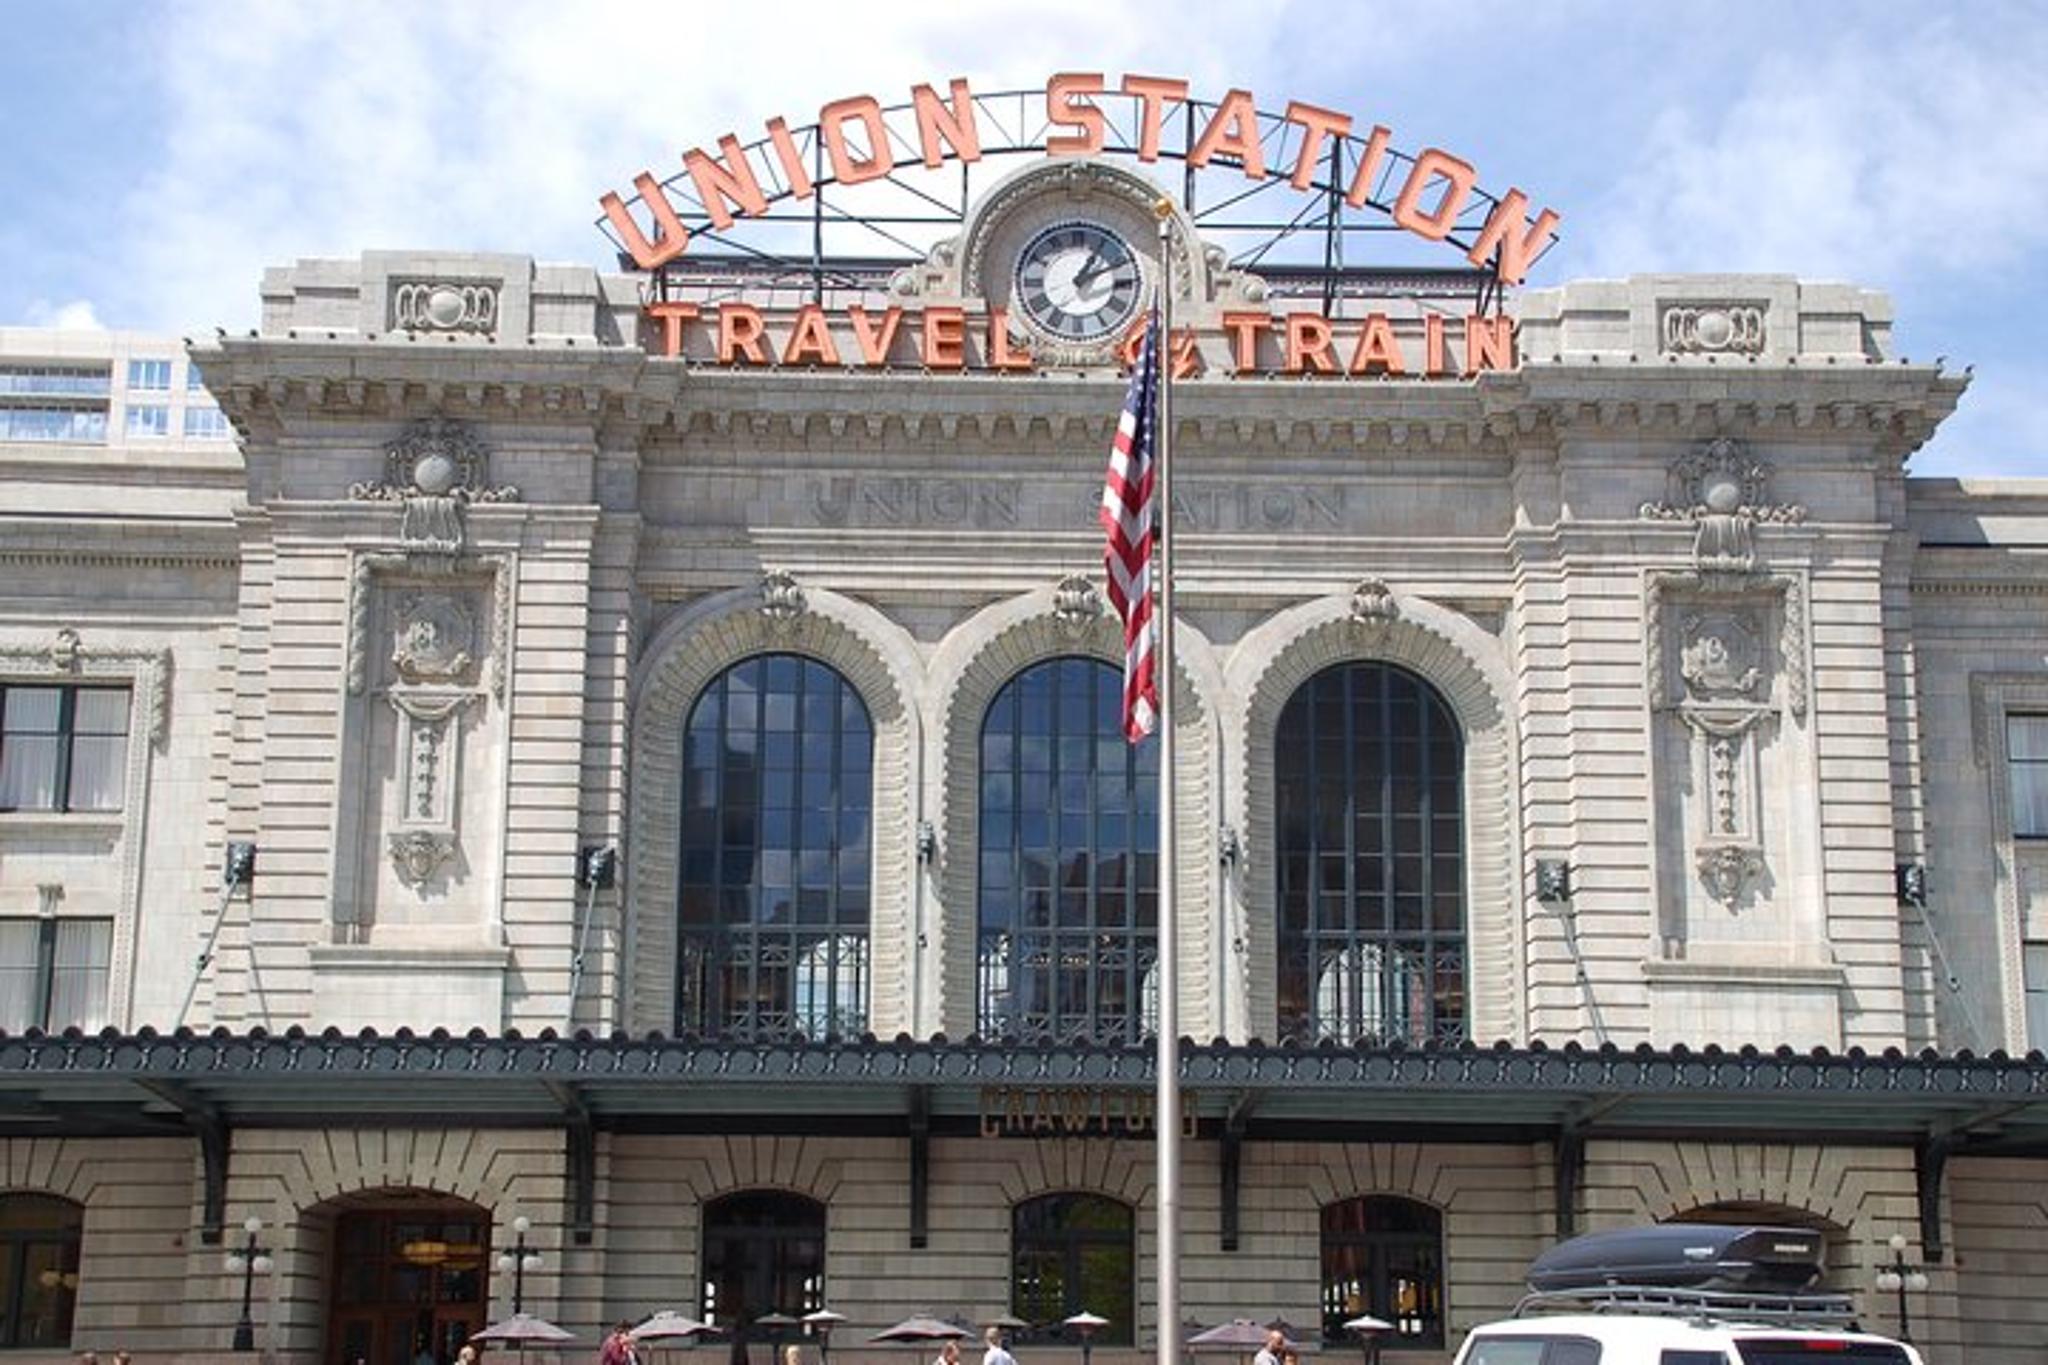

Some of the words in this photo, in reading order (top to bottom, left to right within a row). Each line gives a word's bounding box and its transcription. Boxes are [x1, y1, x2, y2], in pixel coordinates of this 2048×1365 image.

[599, 77, 982, 270] UNION
[1046, 72, 1561, 286] STATION
[647, 302, 1033, 371] TRAVEL
[1222, 311, 1518, 378] TRAIN
[811, 478, 1023, 526] UNION
[1084, 482, 1345, 528] SATION
[980, 1086, 1199, 1138] CRAWFOD
